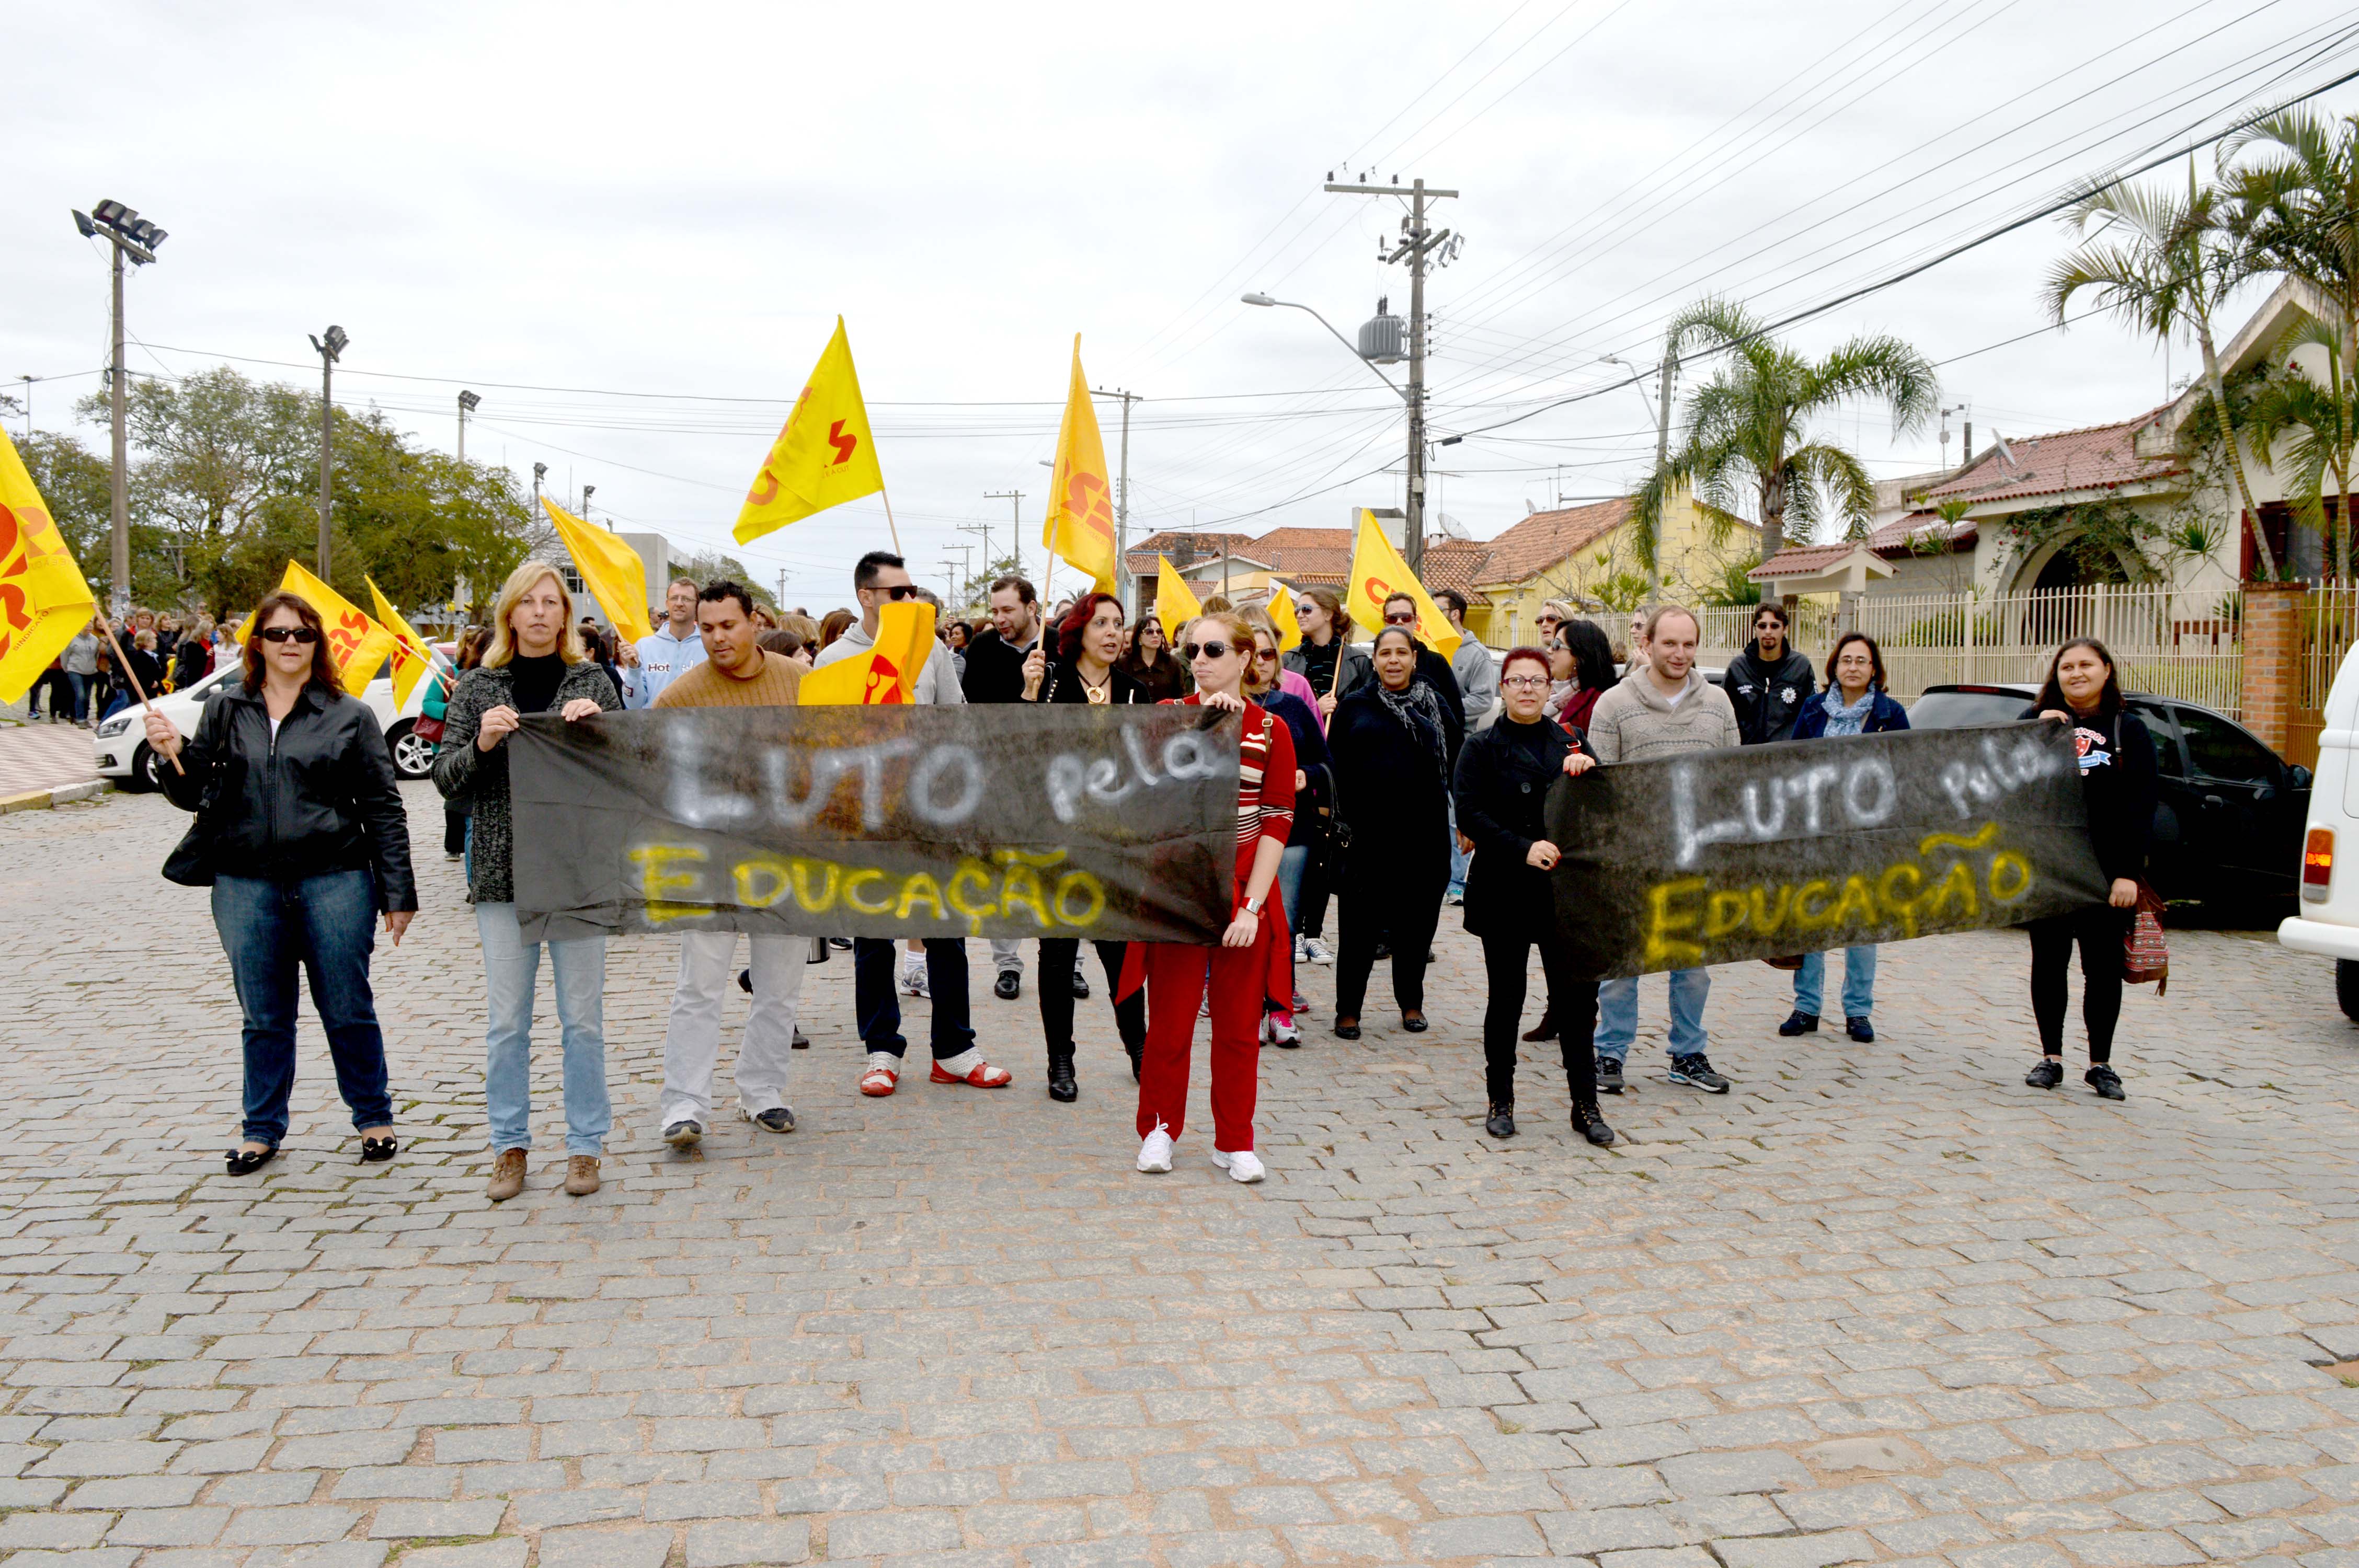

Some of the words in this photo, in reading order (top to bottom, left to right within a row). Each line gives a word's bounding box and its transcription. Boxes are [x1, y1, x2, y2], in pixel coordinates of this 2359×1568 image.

[13, 609, 50, 651] SINDICATO
[648, 663, 670, 673] Hot
[629, 844, 1105, 936] EDUCAÇÃO
[1645, 822, 2031, 964] EDUCAÇÃO
